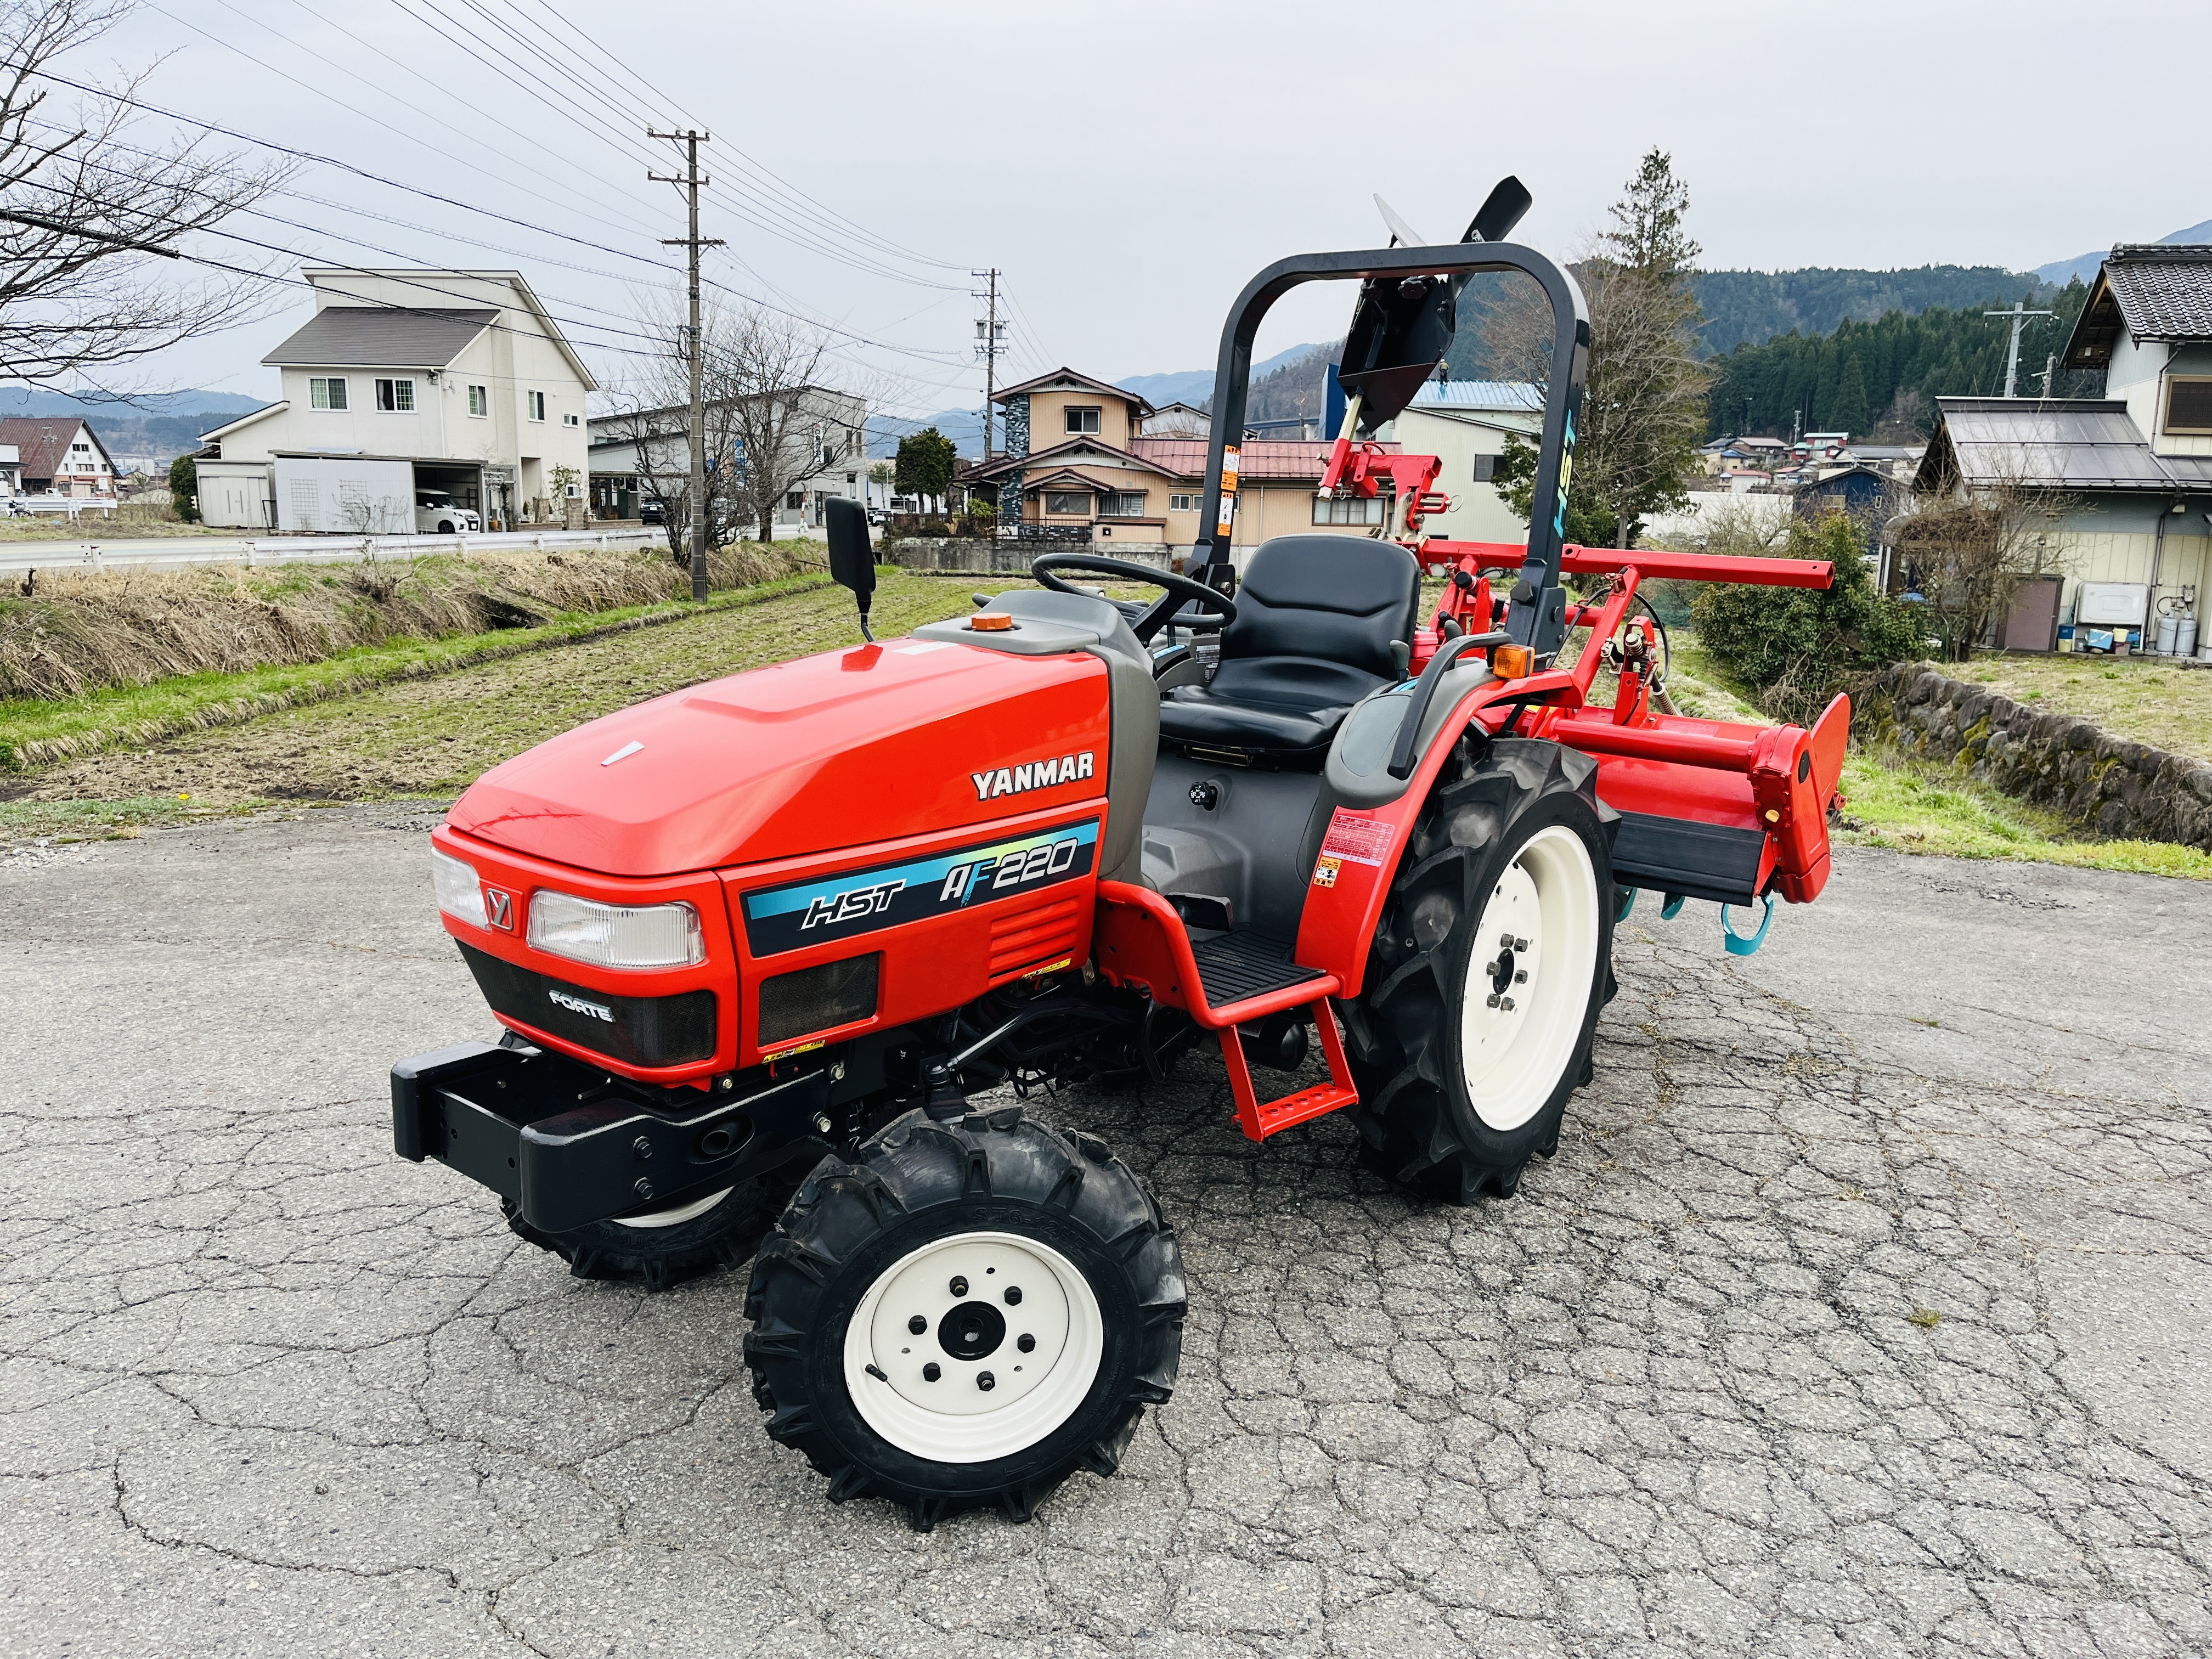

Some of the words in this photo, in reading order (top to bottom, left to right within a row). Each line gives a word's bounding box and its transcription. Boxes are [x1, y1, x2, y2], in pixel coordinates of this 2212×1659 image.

[1553, 408, 1576, 539] HST
[971, 751, 1094, 801] YANMAR
[799, 878, 907, 930] HST
[549, 989, 616, 1023] FORTE
